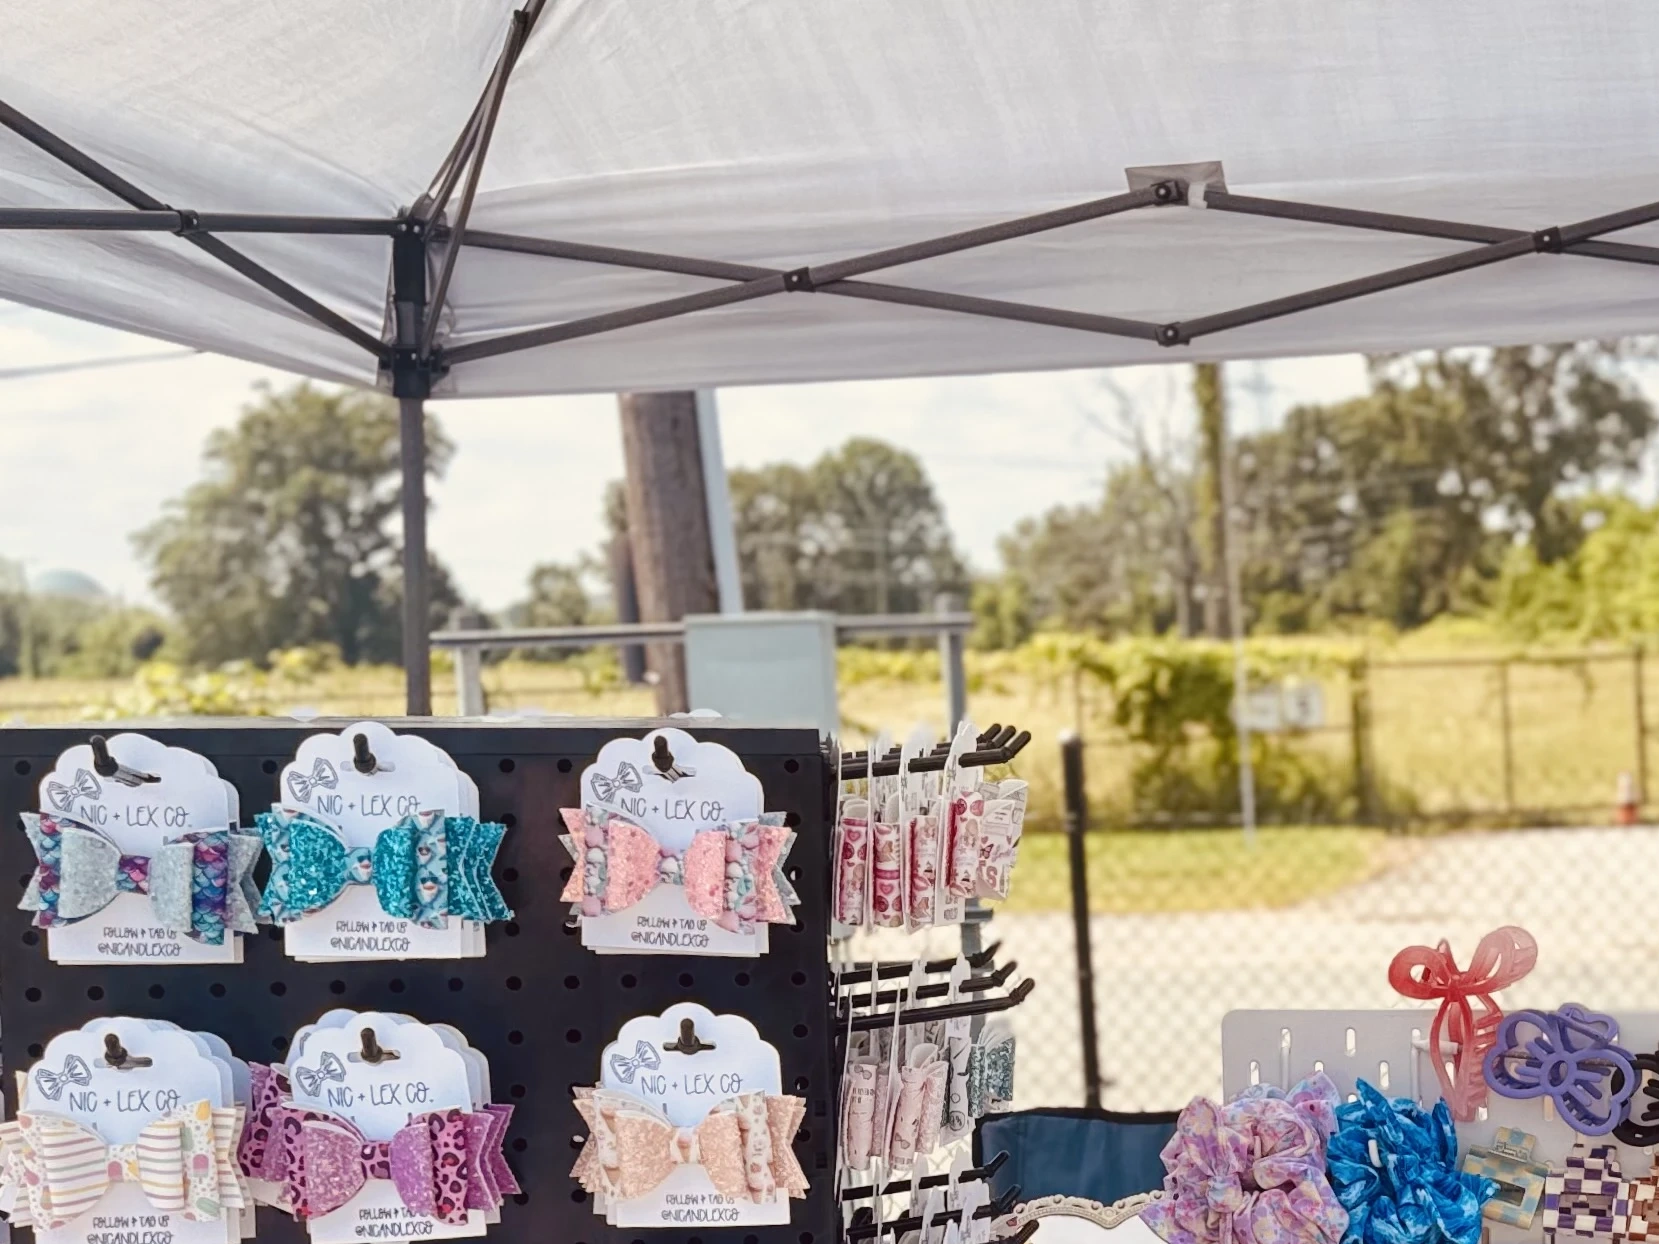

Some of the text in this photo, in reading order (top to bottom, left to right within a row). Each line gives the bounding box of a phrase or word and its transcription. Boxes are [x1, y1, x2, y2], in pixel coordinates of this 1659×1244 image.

[81, 805, 107, 825] NIC
[126, 805, 159, 827] LEX
[318, 795, 342, 815] NIC
[361, 795, 392, 817] LEX
[620, 798, 646, 817] NIC
[665, 799, 695, 821] LEX
[641, 1075, 666, 1095] NIC
[685, 1073, 715, 1095] LEX
[70, 1092, 97, 1112] NIC
[117, 1090, 150, 1112] LEX
[328, 1087, 353, 1107] NIC
[370, 1084, 401, 1106] LEX
